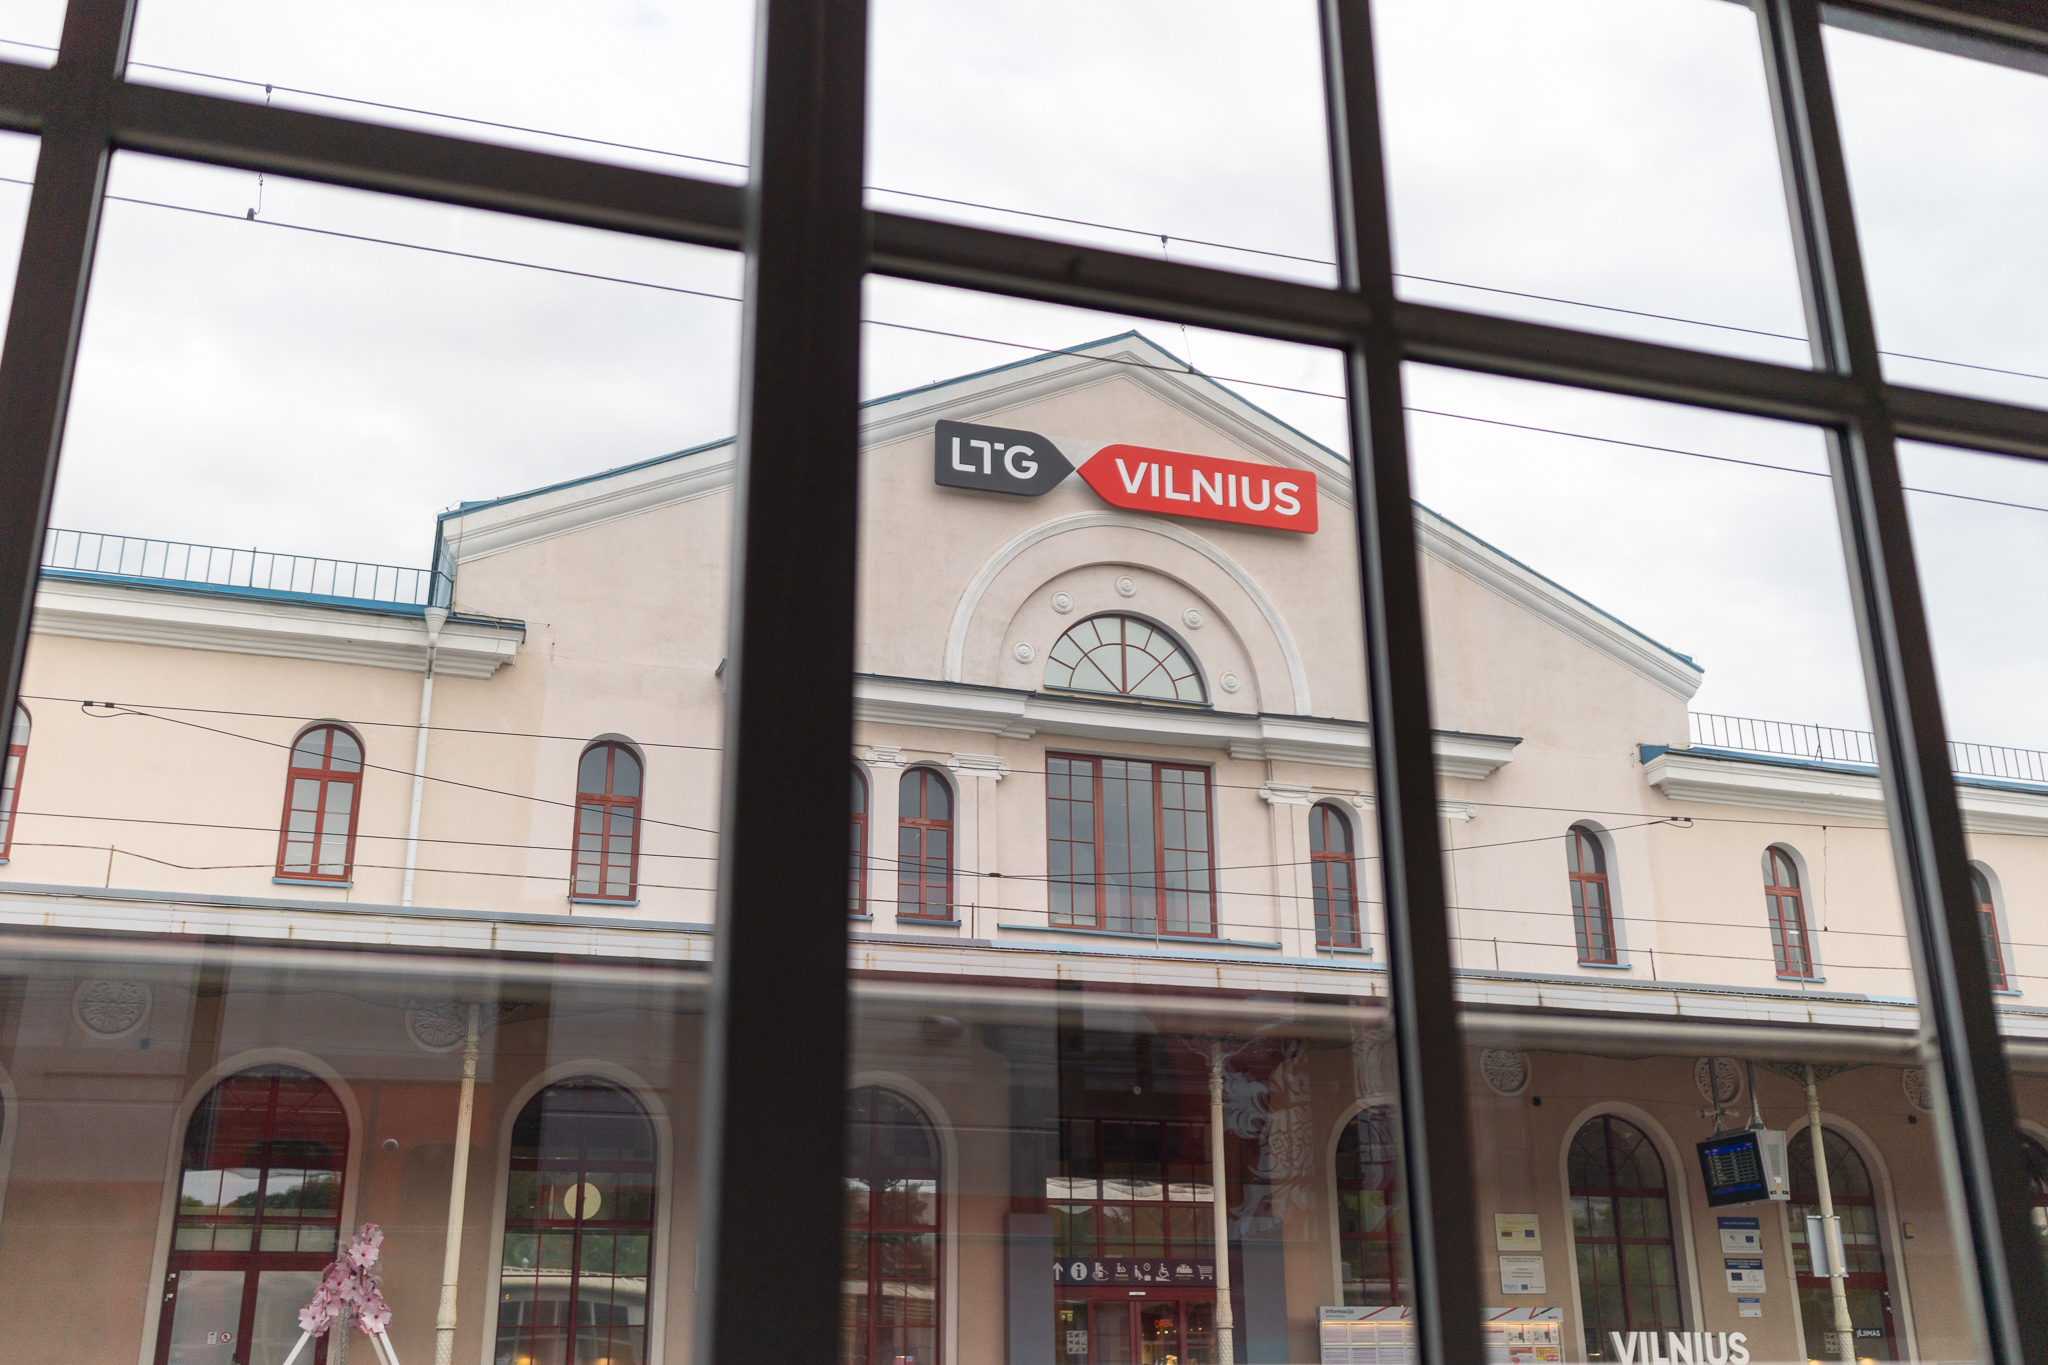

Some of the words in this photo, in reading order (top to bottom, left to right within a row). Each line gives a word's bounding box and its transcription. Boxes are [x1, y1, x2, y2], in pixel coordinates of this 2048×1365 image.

[951, 436, 1039, 480] LTG
[1114, 457, 1302, 516] VILNIUS
[1609, 1331, 1750, 1365] VILNIUS
